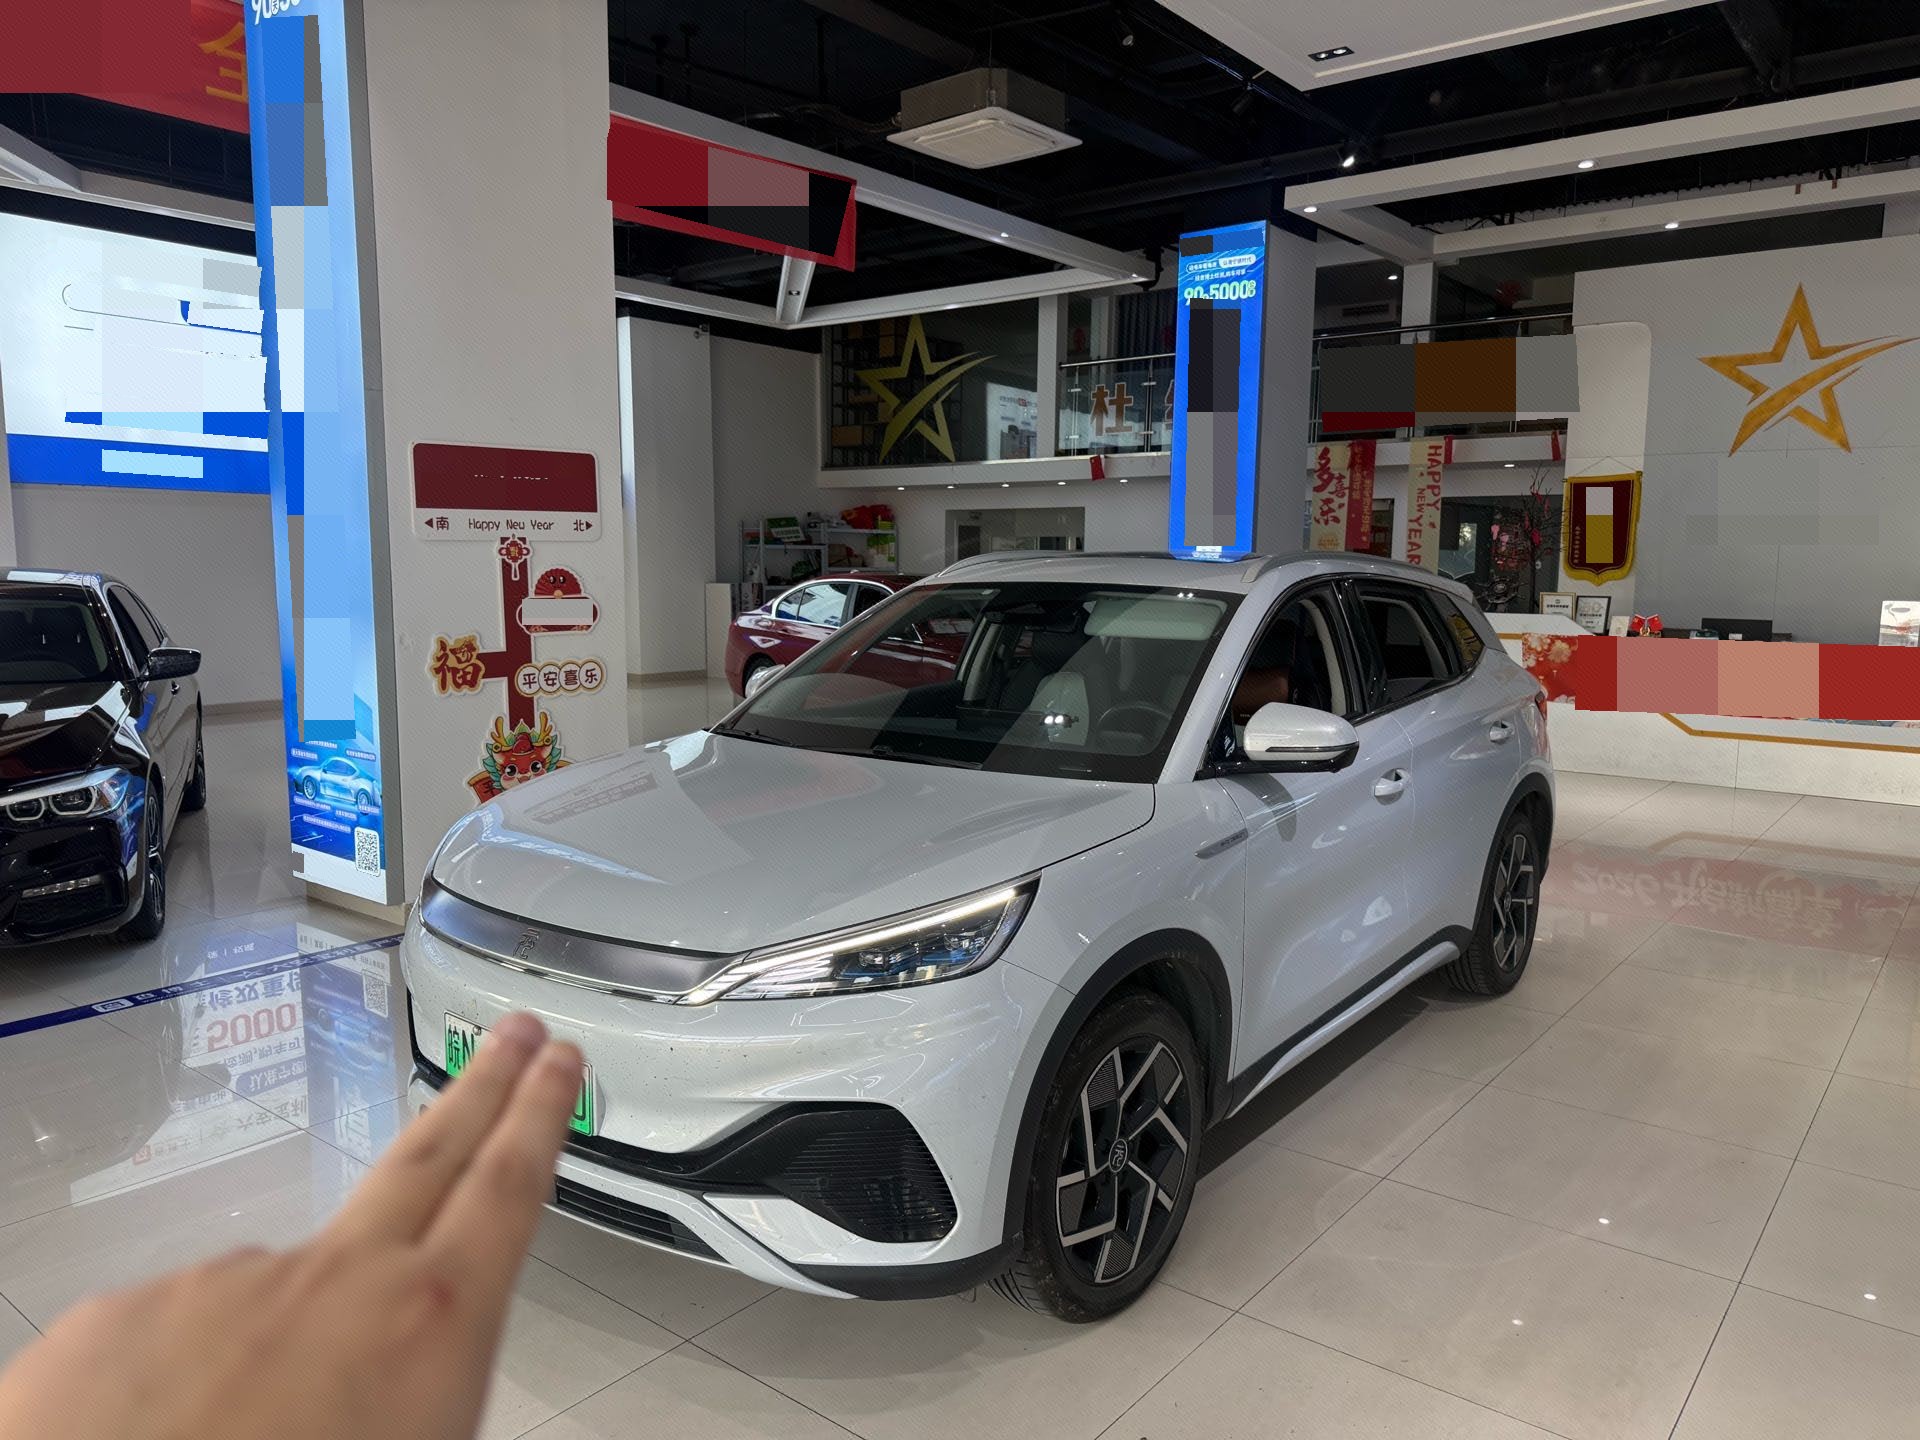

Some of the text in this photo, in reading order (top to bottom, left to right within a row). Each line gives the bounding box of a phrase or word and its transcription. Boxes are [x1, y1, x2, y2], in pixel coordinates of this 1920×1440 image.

[1427, 445, 1443, 511] HAPPY
[1417, 488, 1426, 514] NEW
[436, 516, 449, 531] 南
[468, 518, 554, 531] Happy New Year
[573, 519, 584, 532] 北
[1407, 517, 1423, 566] YEAR
[433, 639, 483, 691] 福
[521, 667, 600, 690] 平安喜乐
